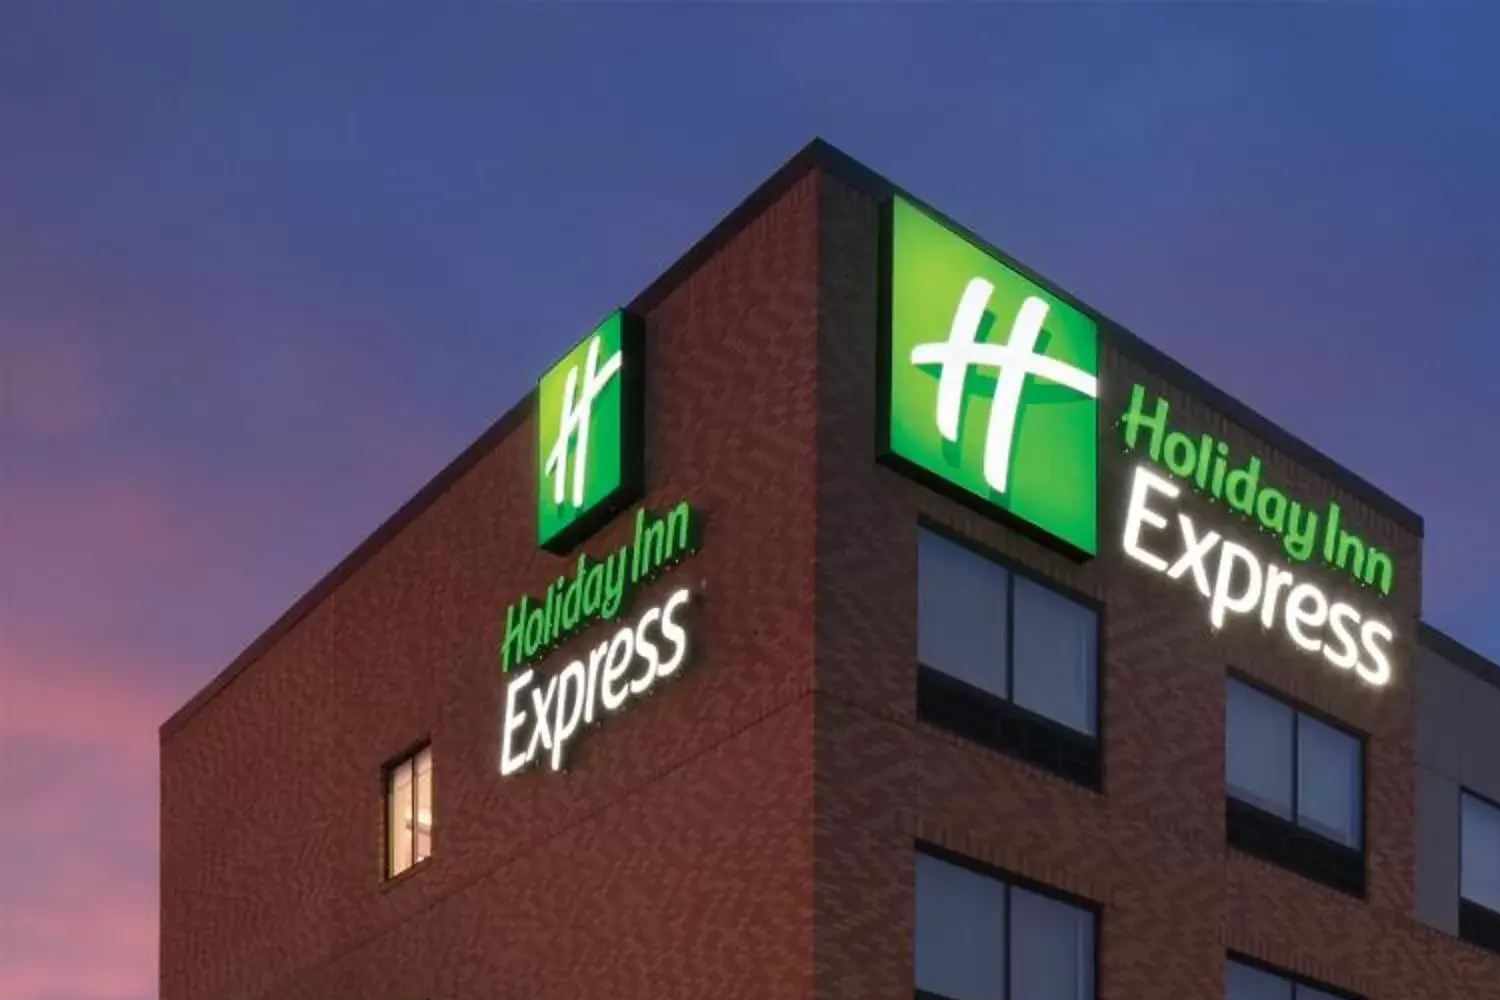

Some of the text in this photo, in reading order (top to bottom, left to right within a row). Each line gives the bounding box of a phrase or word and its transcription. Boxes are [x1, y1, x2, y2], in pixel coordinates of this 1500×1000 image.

[545, 335, 622, 507] H
[911, 276, 1098, 494] H
[502, 502, 688, 672] Holiday Inn
[1122, 384, 1393, 596] Holiday Inn
[1122, 465, 1394, 687] Express
[500, 588, 689, 775] Express
